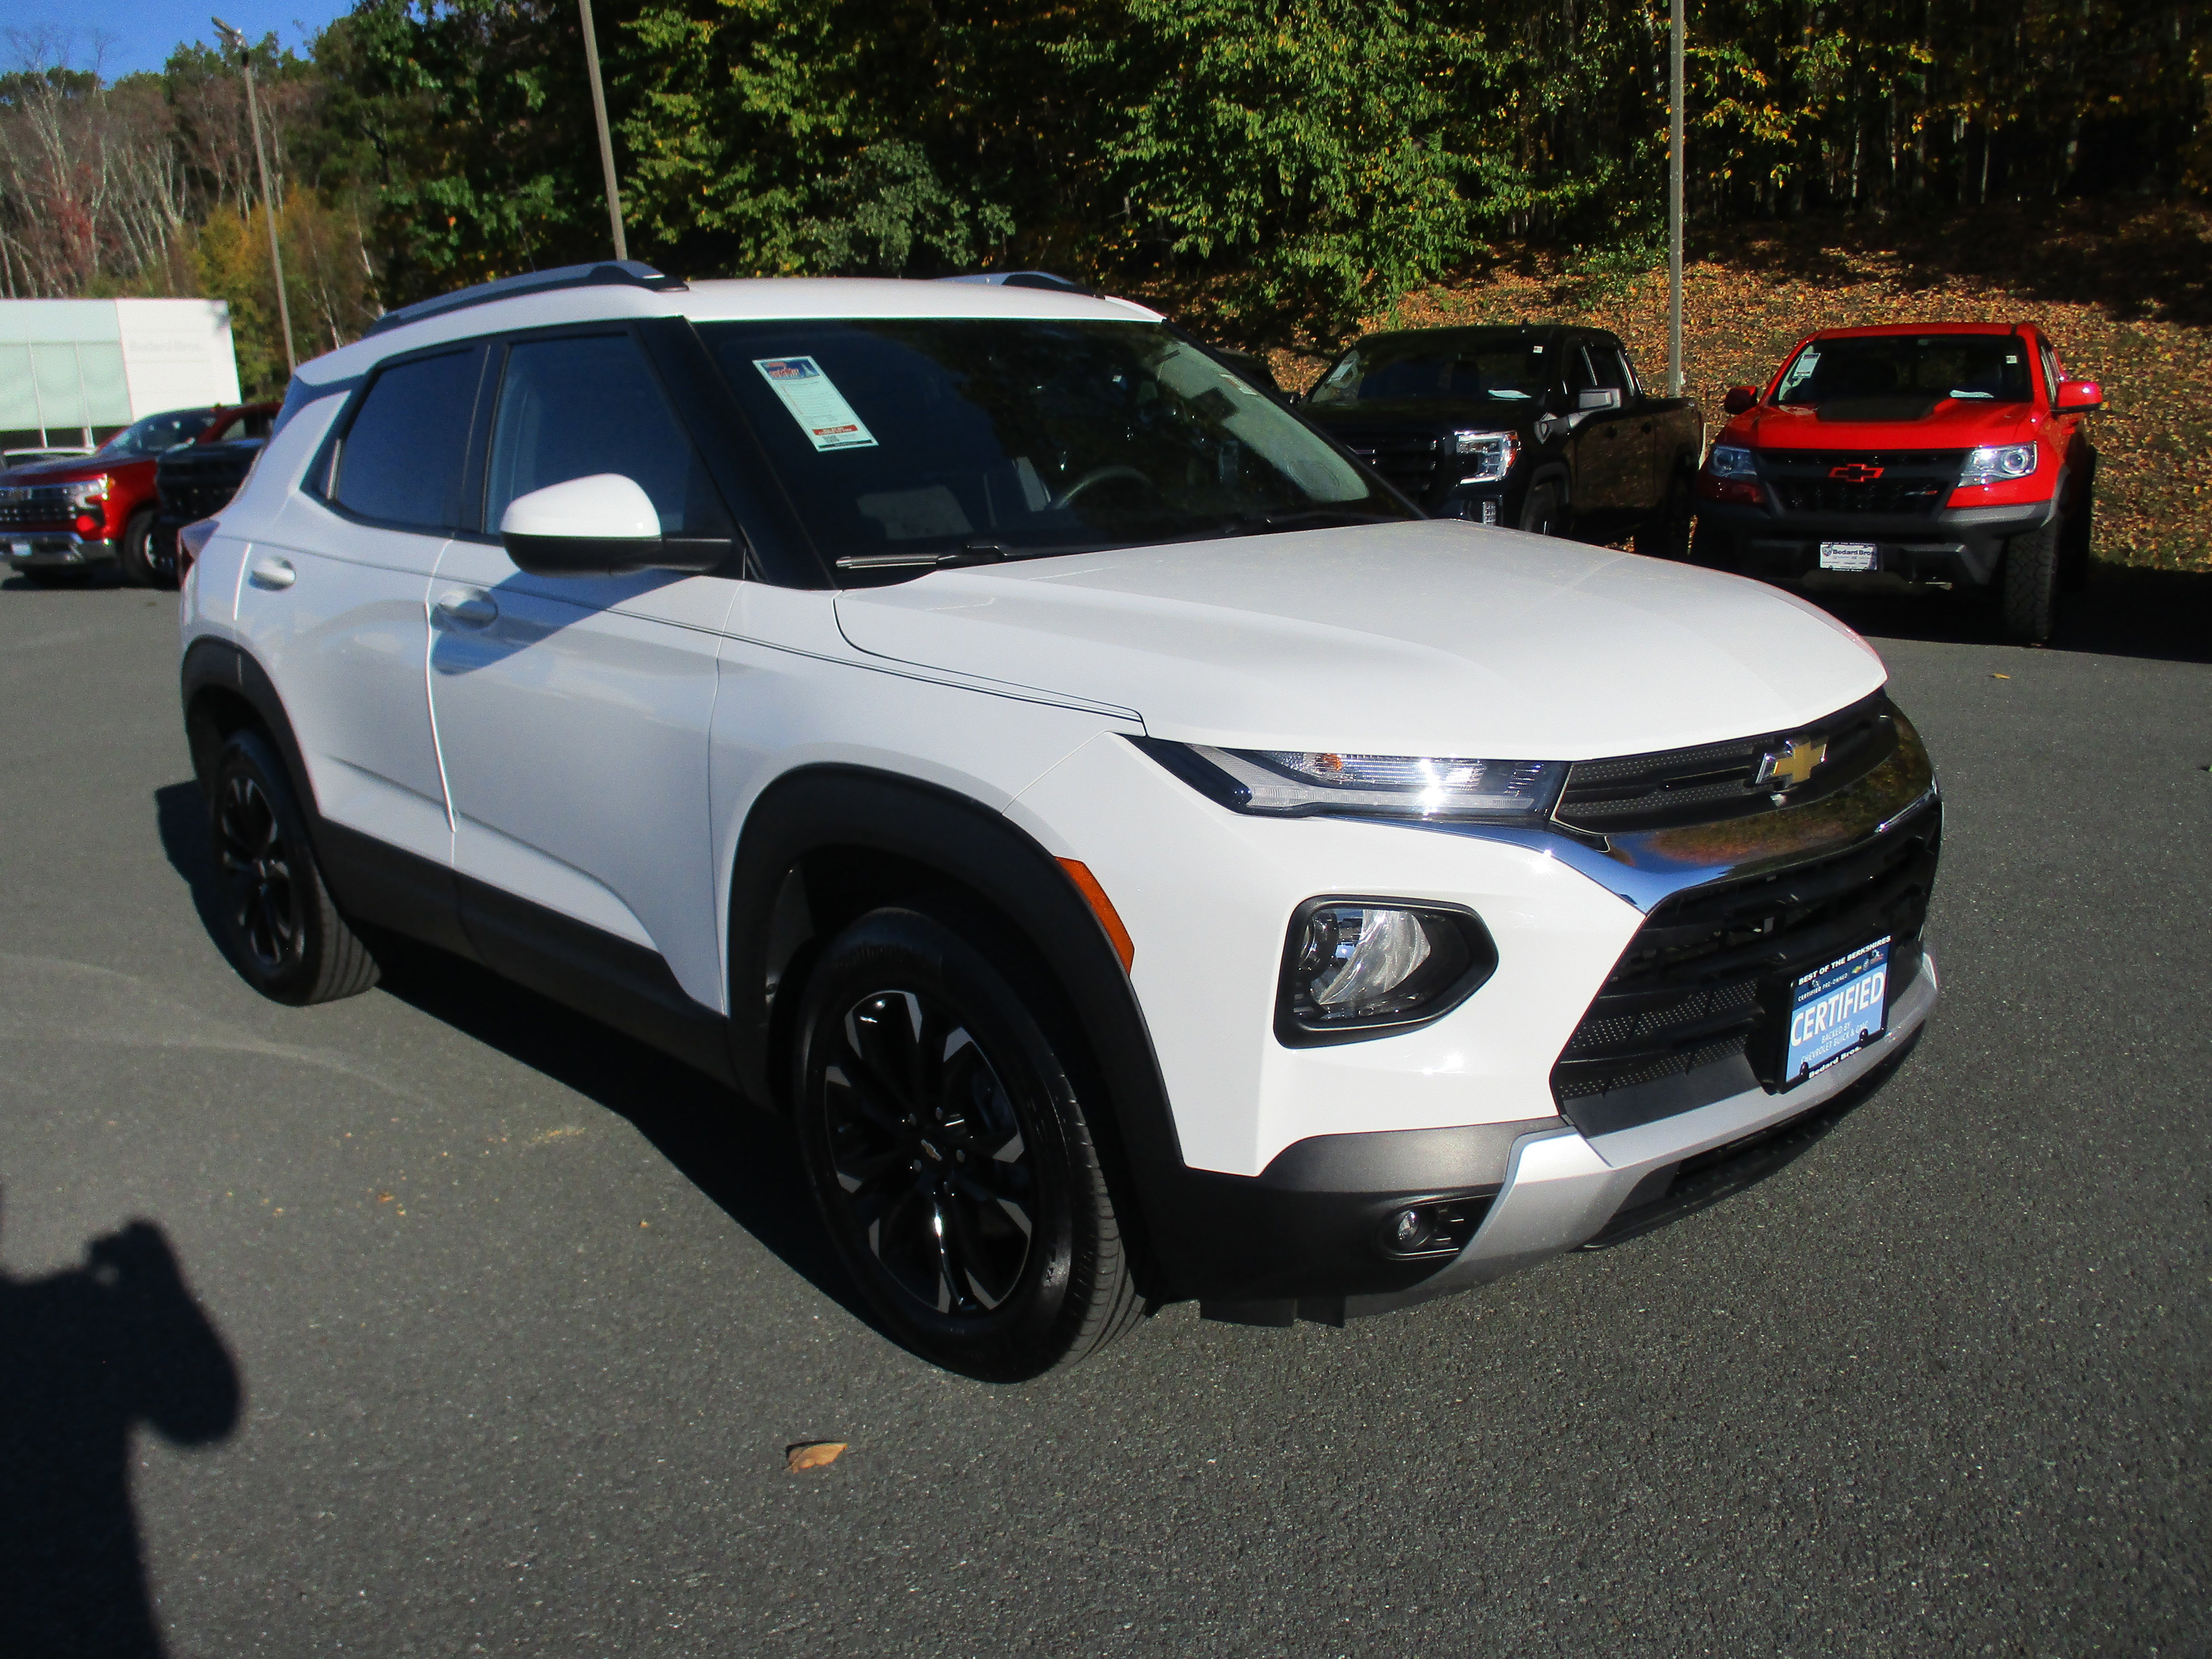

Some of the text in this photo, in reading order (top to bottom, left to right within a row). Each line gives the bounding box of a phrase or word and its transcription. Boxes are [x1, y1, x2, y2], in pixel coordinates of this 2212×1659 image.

[1799, 970, 1818, 986] BEST
[1819, 964, 1830, 975] OF
[1831, 957, 1846, 969] THE
[1847, 935, 1891, 962] BERKSHIRES
[1798, 972, 1848, 1002] CERTIFIED PRE-OWNED
[1790, 972, 1885, 1047] CERTIFIED
[1801, 1020, 1869, 1064] CHEVROLET BUICK & GMC
[1821, 1021, 1851, 1044] BACKED BY
[1809, 1046, 1862, 1079] Bedard Bros.
